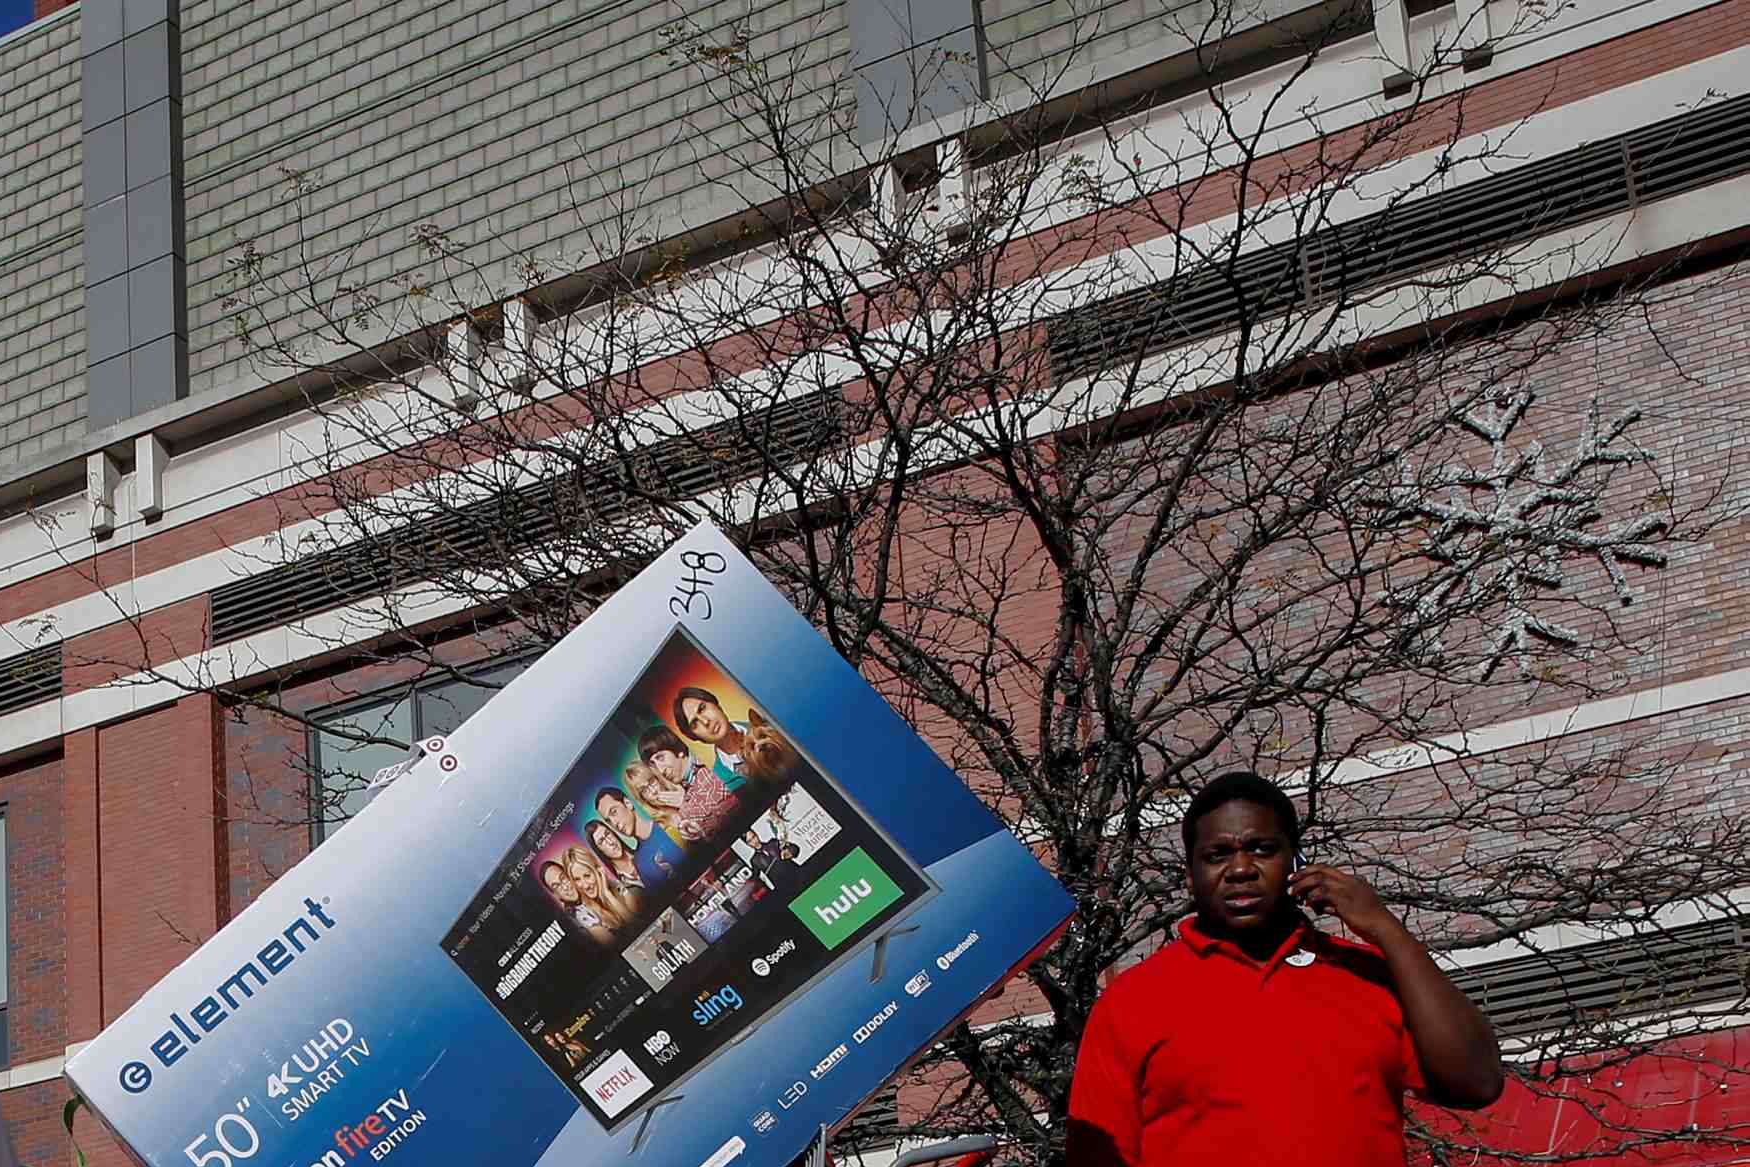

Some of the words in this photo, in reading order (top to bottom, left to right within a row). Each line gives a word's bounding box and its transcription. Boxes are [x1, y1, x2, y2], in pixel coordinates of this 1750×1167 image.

[669, 551, 727, 620] 348
[813, 877, 873, 925] hulu
[651, 938, 696, 981] GOLIATH
[765, 938, 796, 966] Spotify
[150, 897, 337, 1068] element
[693, 984, 744, 1026] sling
[867, 1000, 899, 1032] DOLBY
[266, 1061, 303, 1099] 4K
[291, 1017, 355, 1073] UHD
[643, 1030, 671, 1057] HBO
[654, 1041, 681, 1067] NOW
[810, 1043, 848, 1079] HDMI
[281, 1059, 345, 1122] SMART
[341, 1037, 371, 1067] TV
[595, 1065, 637, 1103] NETFLIX
[777, 1081, 808, 1110] LED
[369, 1109, 427, 1162] EDITION
